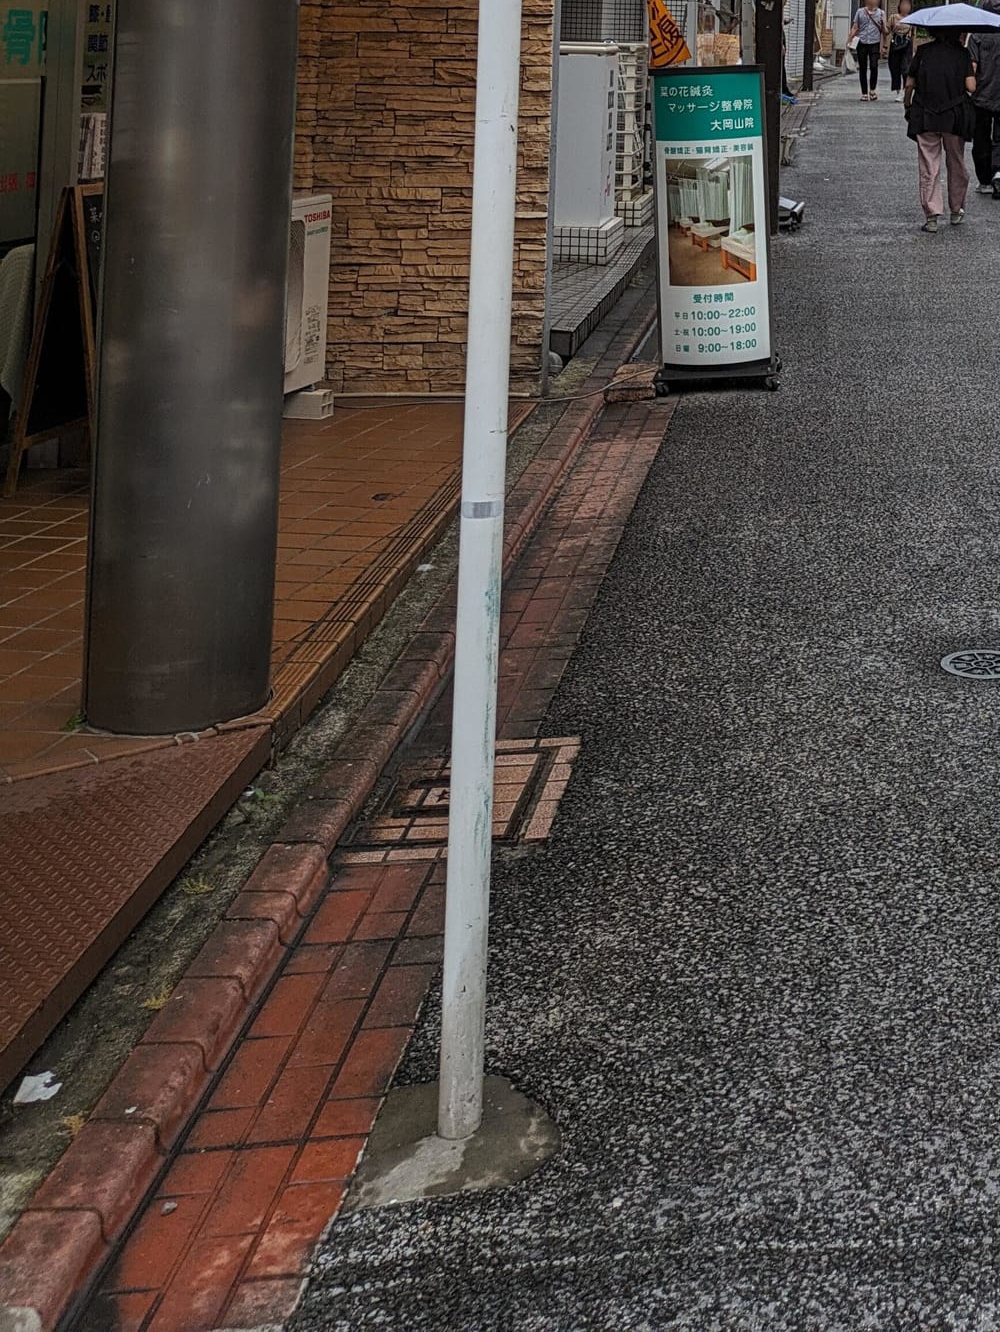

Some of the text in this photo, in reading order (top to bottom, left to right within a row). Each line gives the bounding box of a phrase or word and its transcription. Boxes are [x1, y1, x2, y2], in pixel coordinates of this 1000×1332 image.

[668, 99, 753, 113] マッサージ整骨院
[711, 117, 754, 131] 大岡山院
[304, 210, 331, 223] TOSHIBA
[693, 292, 734, 304] 受付時間
